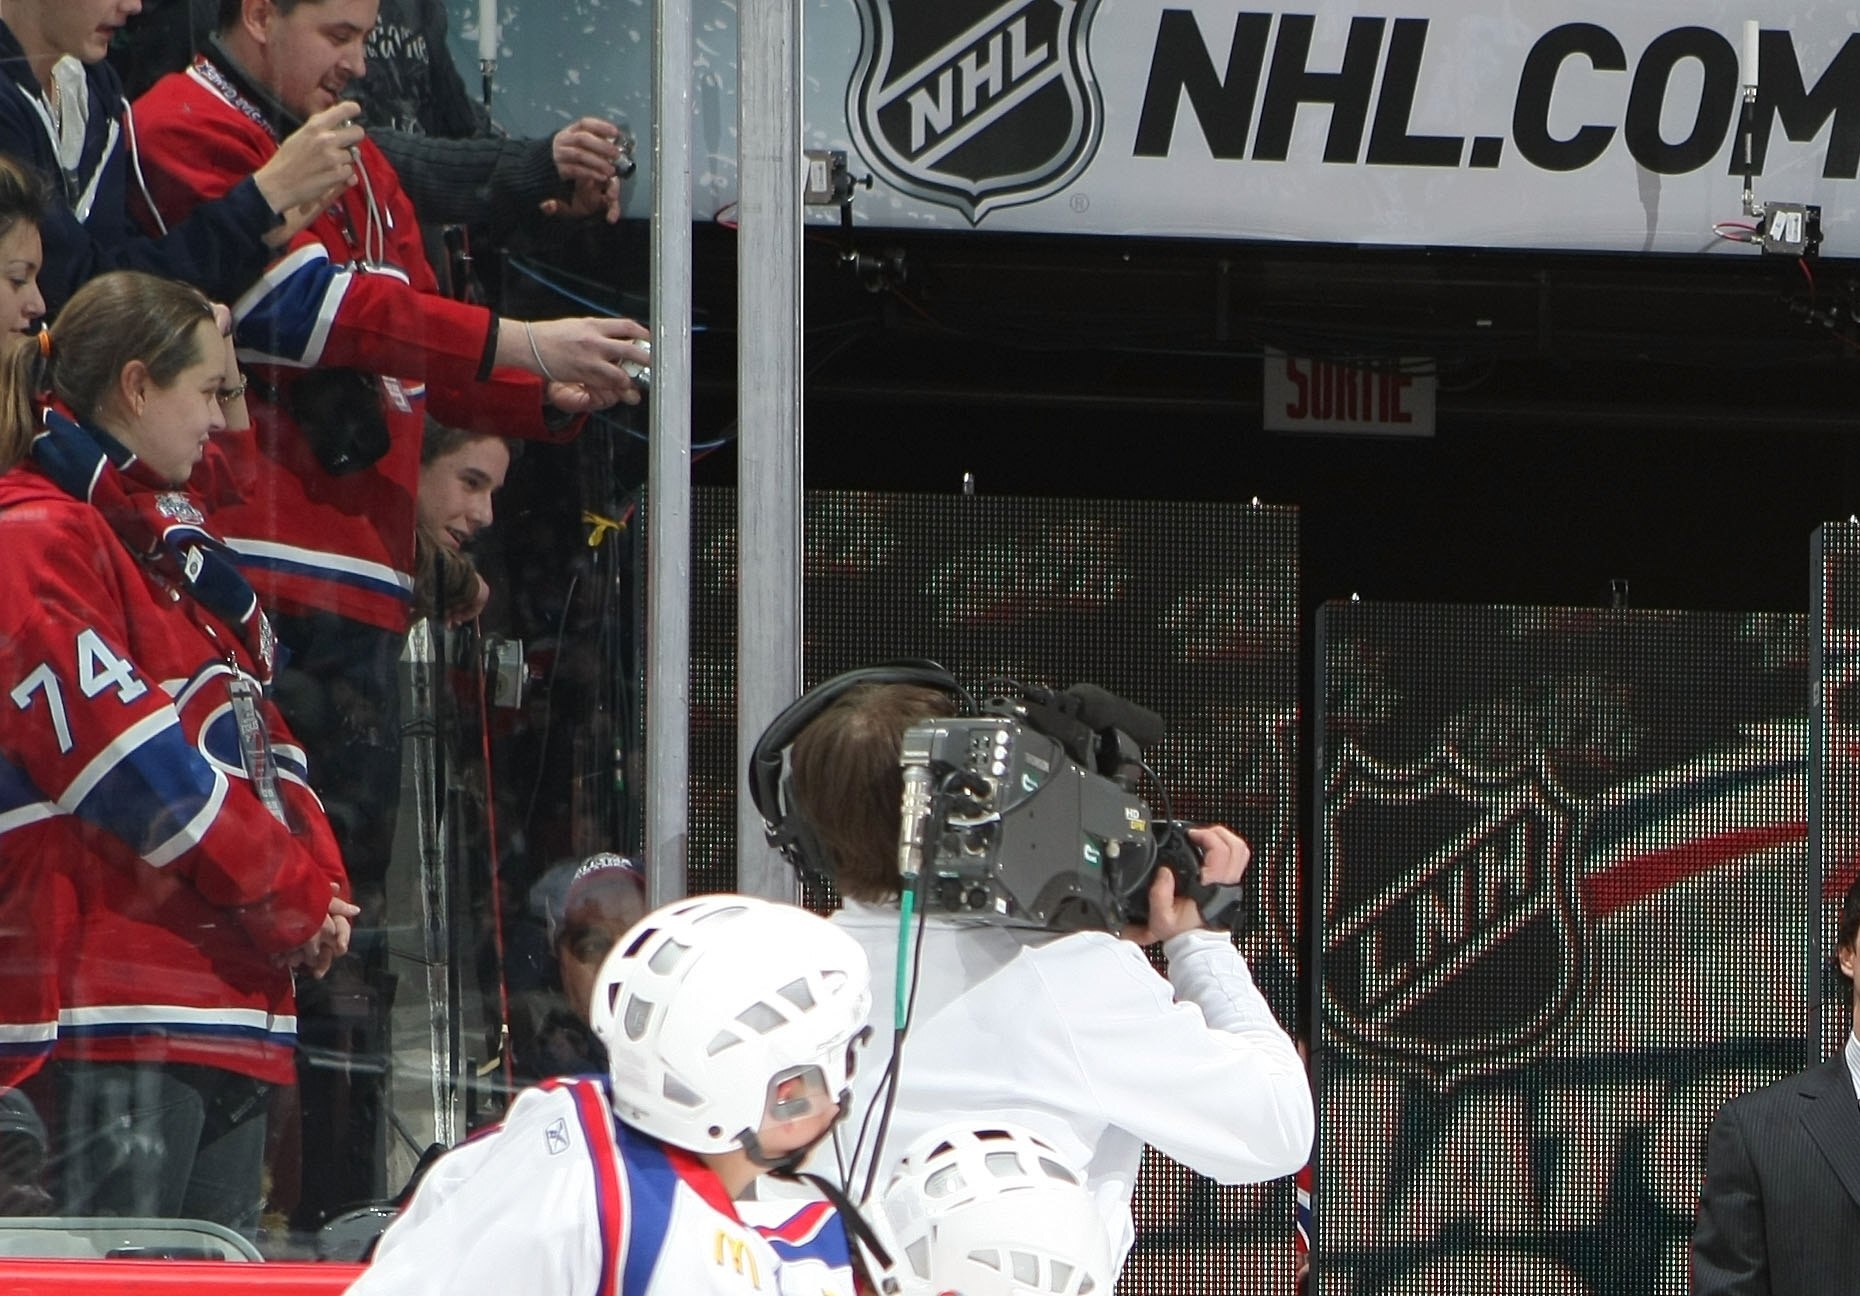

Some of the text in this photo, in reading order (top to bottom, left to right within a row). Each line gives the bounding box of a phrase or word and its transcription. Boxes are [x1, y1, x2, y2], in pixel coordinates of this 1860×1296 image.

[907, 16, 1049, 153] NHL
[10, 628, 148, 755] 74
[1361, 820, 1530, 1005] LNH
